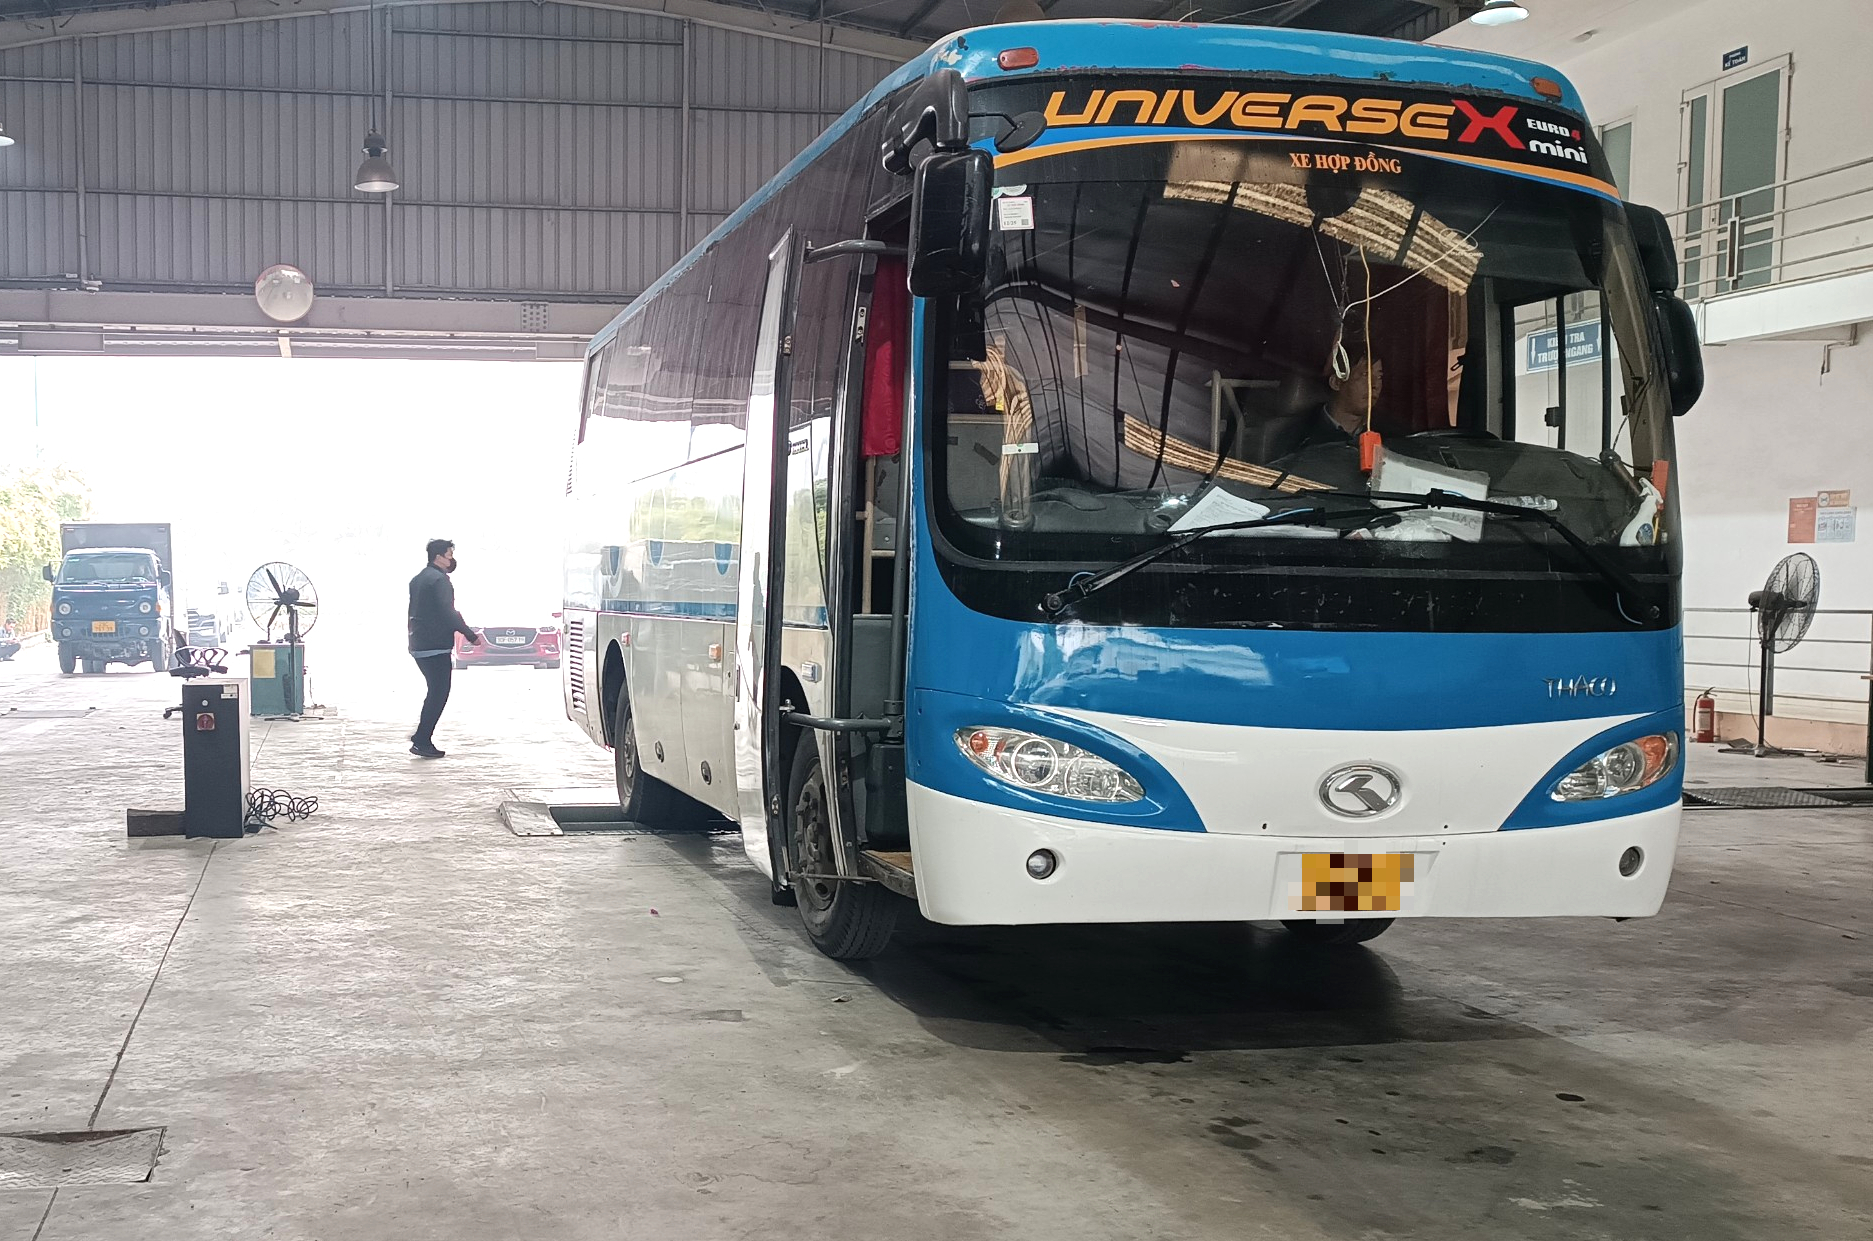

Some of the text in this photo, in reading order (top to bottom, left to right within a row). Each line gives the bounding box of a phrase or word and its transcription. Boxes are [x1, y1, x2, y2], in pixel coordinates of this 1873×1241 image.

[1526, 118, 1570, 138] EURO
[1529, 139, 1588, 164] mini
[1289, 151, 1402, 174] XE HỢP ĐỒNG
[1570, 332, 1585, 344] TRA
[1566, 344, 1594, 358] NGANG
[1541, 674, 1618, 698] THACO
